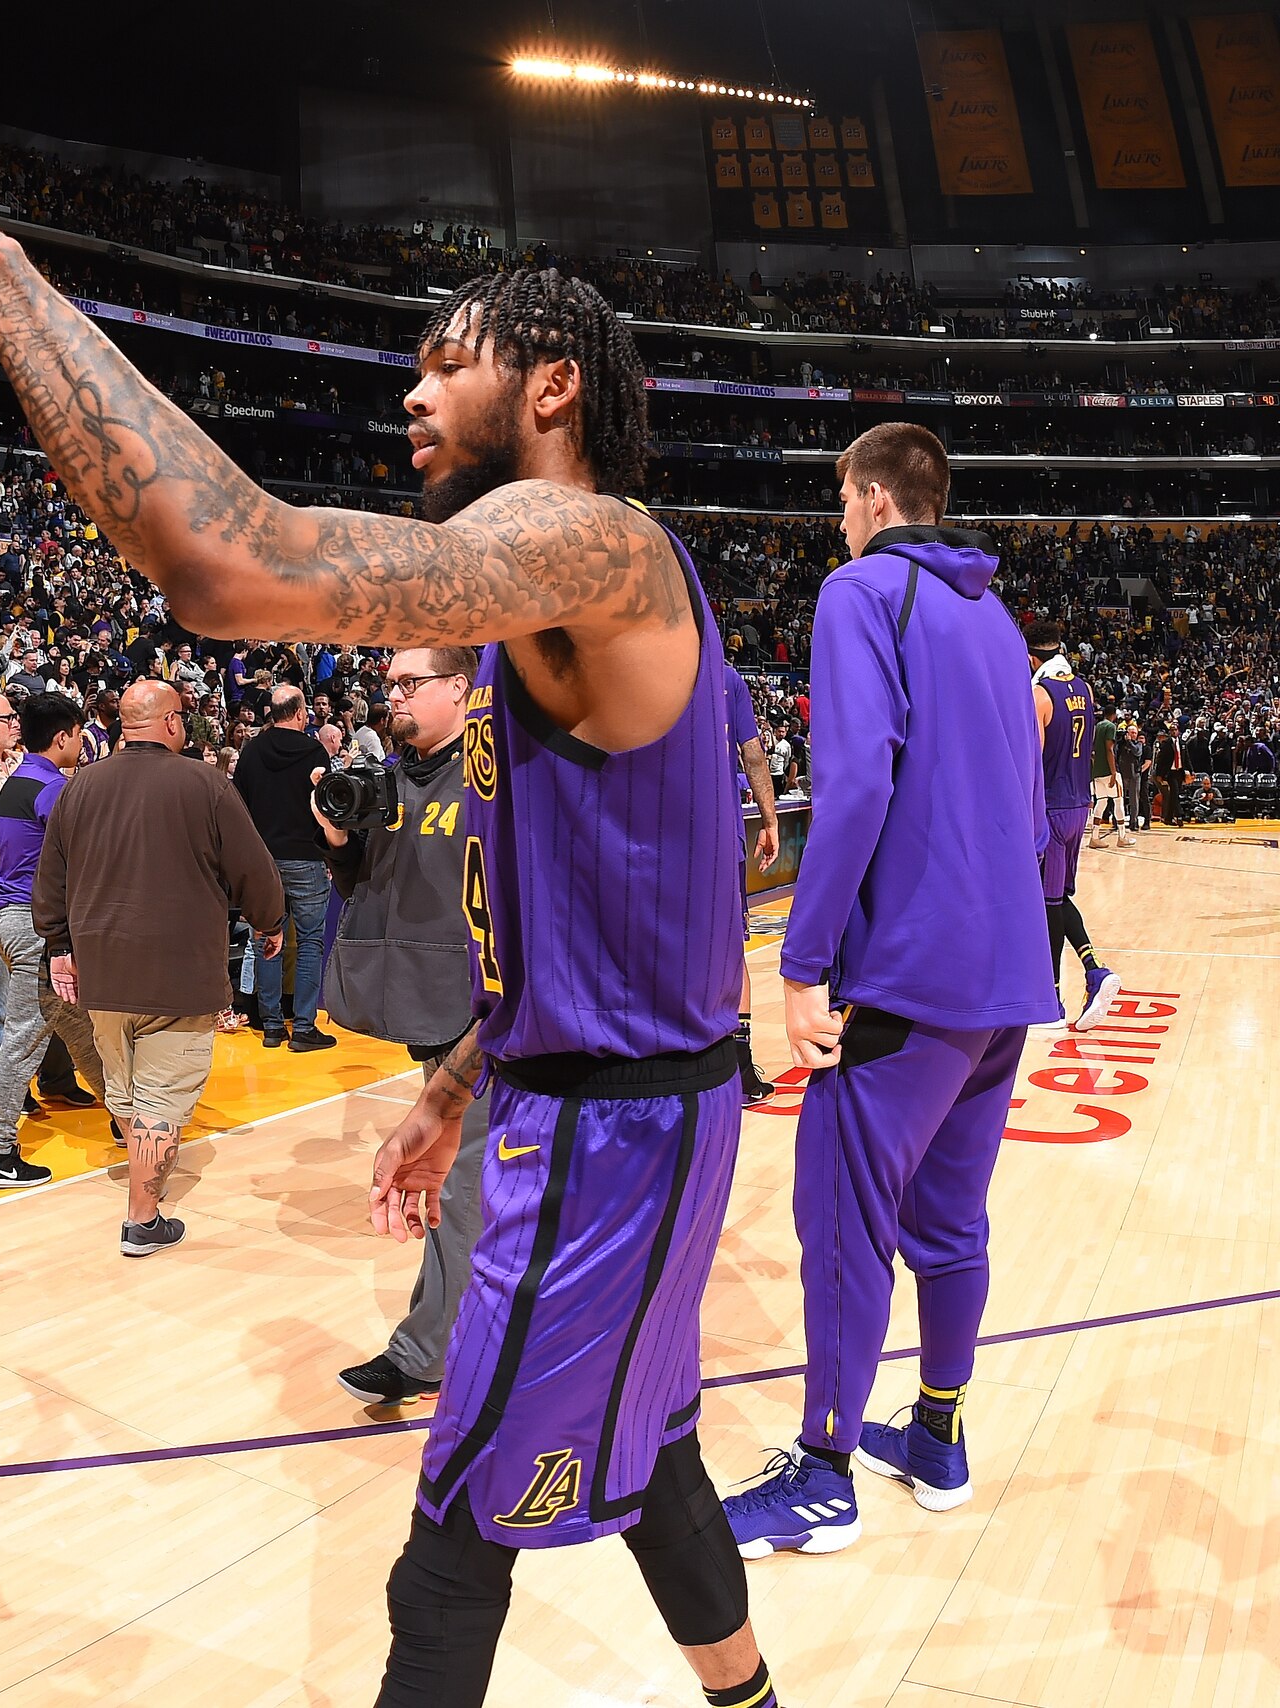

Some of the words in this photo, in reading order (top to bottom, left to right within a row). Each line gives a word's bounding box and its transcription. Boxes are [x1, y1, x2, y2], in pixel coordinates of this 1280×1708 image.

[825, 204, 841, 216] 24
[204, 325, 273, 346] #WEGOTTACOS
[714, 382, 776, 397] #WEGOTTACOS
[956, 394, 1003, 405] TOYOTA
[1140, 395, 1174, 405] DELTA
[1178, 395, 1222, 406] STAPLES
[225, 403, 275, 420] Spectrum
[367, 420, 409, 435] StubHub
[746, 450, 781, 460] DELTA
[1072, 715, 1085, 758] 7
[420, 801, 460, 836] 24
[494, 1448, 580, 1529] LA
